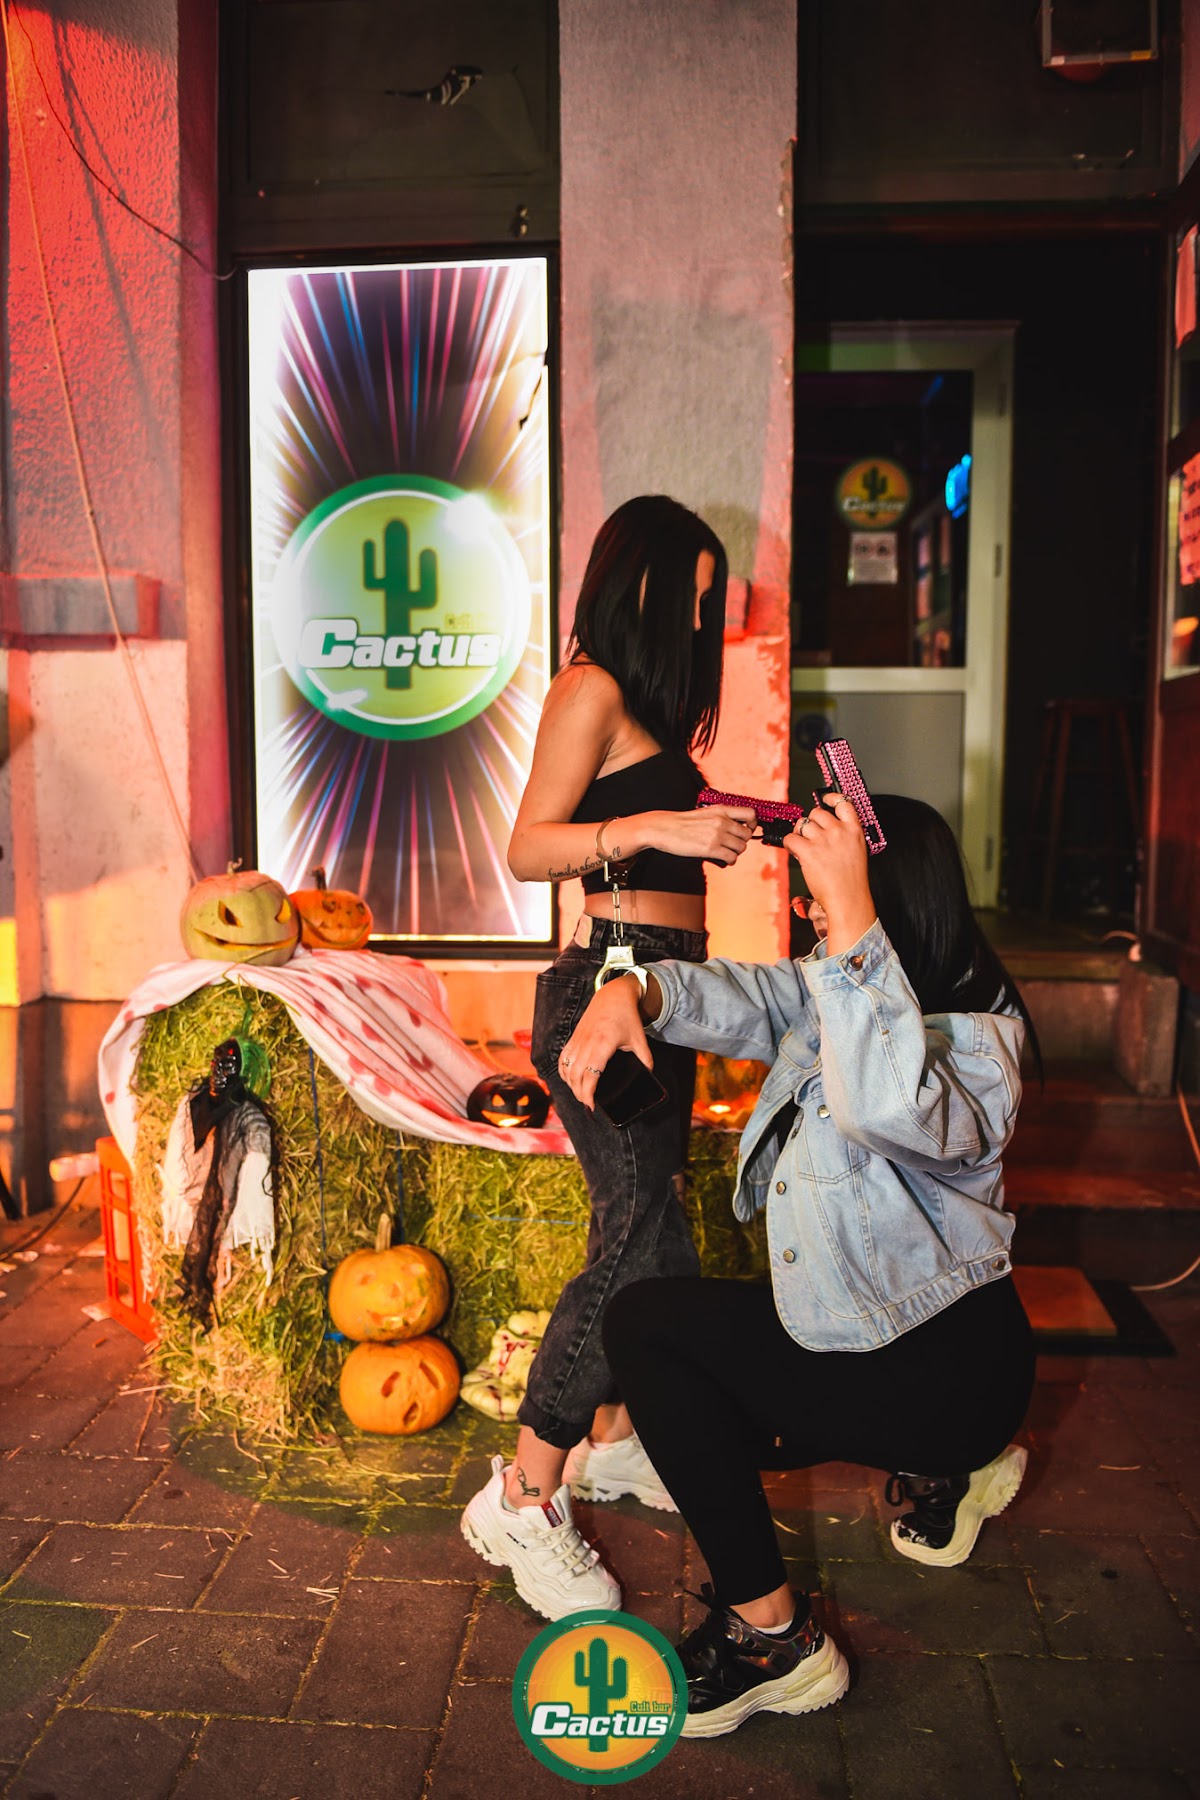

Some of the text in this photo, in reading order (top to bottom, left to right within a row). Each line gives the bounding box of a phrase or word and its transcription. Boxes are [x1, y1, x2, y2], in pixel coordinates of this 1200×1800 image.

[299, 618, 500, 668] Cactus
[547, 863, 579, 881] family
[580, 856, 606, 871] abov
